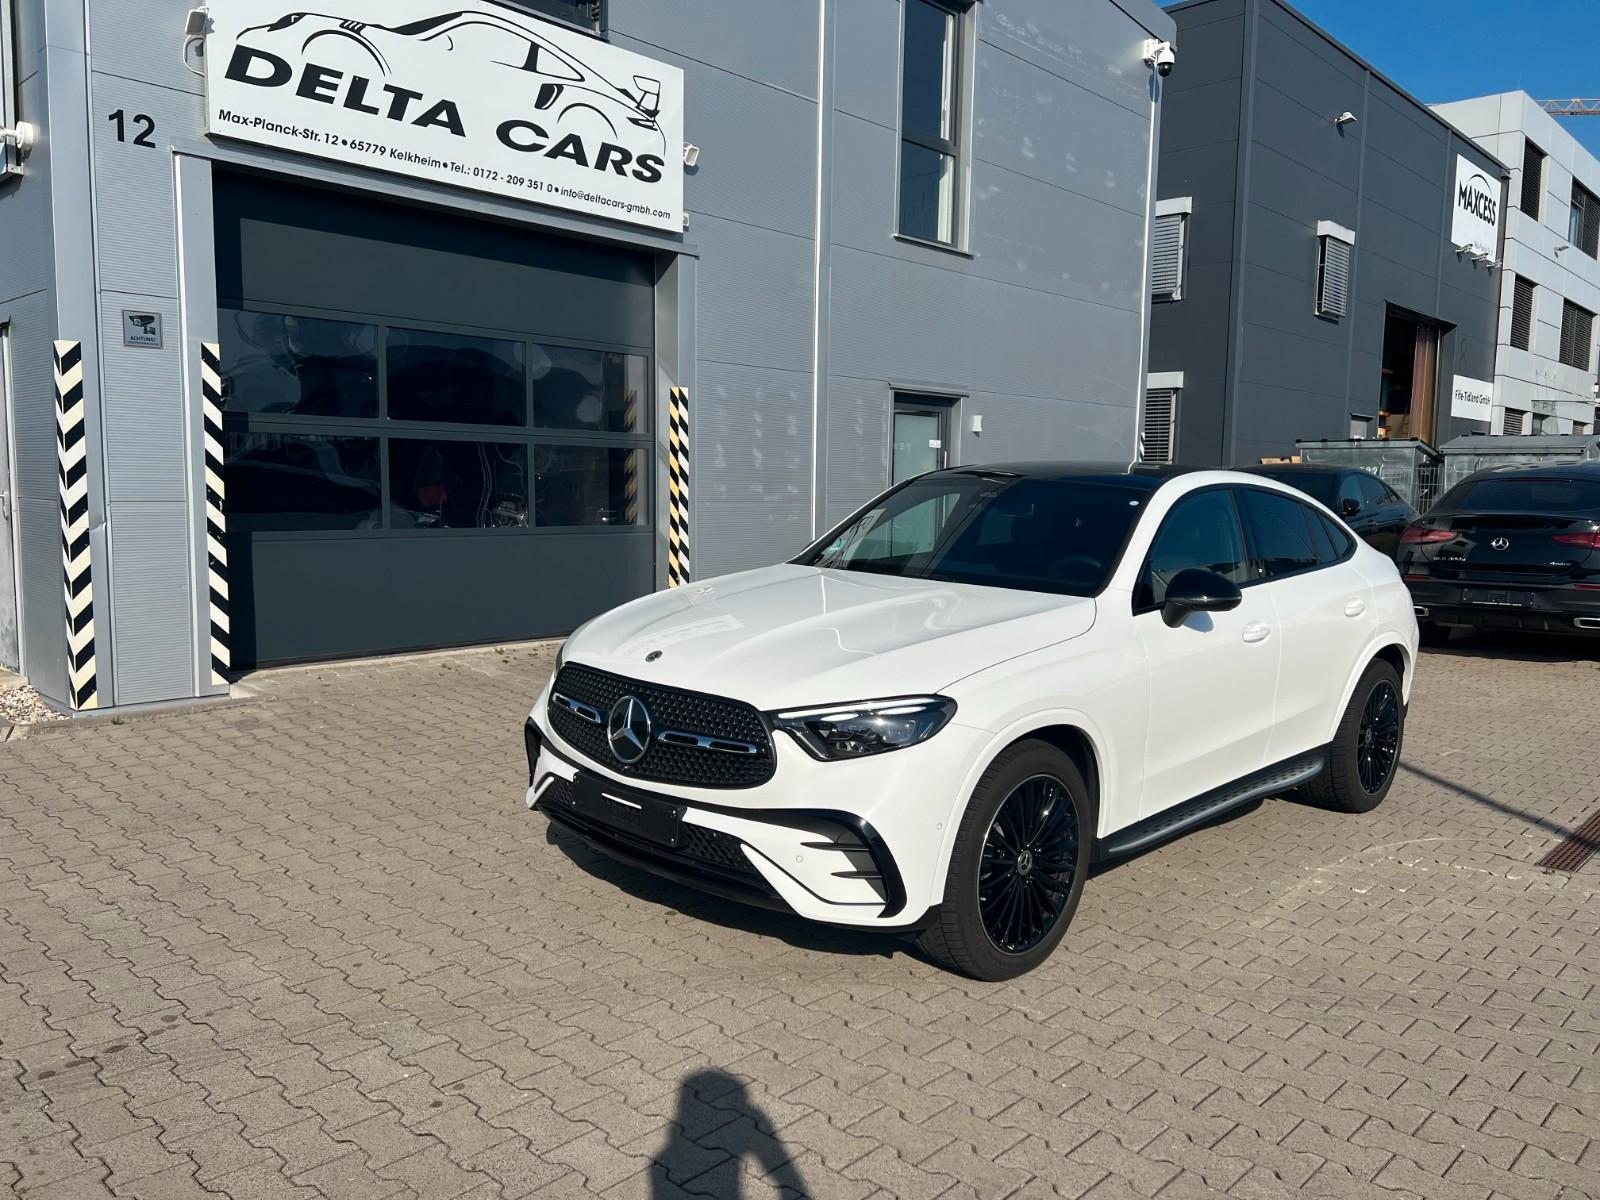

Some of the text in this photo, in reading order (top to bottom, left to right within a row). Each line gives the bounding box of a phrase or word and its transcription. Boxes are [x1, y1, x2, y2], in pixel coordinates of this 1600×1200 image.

[107, 108, 157, 150] 12
[224, 43, 665, 184] DELTA CARS
[218, 109, 321, 142] Max-Planck-Str.
[324, 132, 339, 146] 12
[349, 139, 387, 156] 65779
[389, 147, 441, 169] Kelkheim
[472, 167, 498, 181] 0172
[506, 174, 525, 187] 209
[526, 178, 544, 191] 351
[546, 183, 553, 193] 0
[560, 187, 671, 219] info@deltacars-gmbh.com
[1458, 180, 1497, 226] MAXCESS
